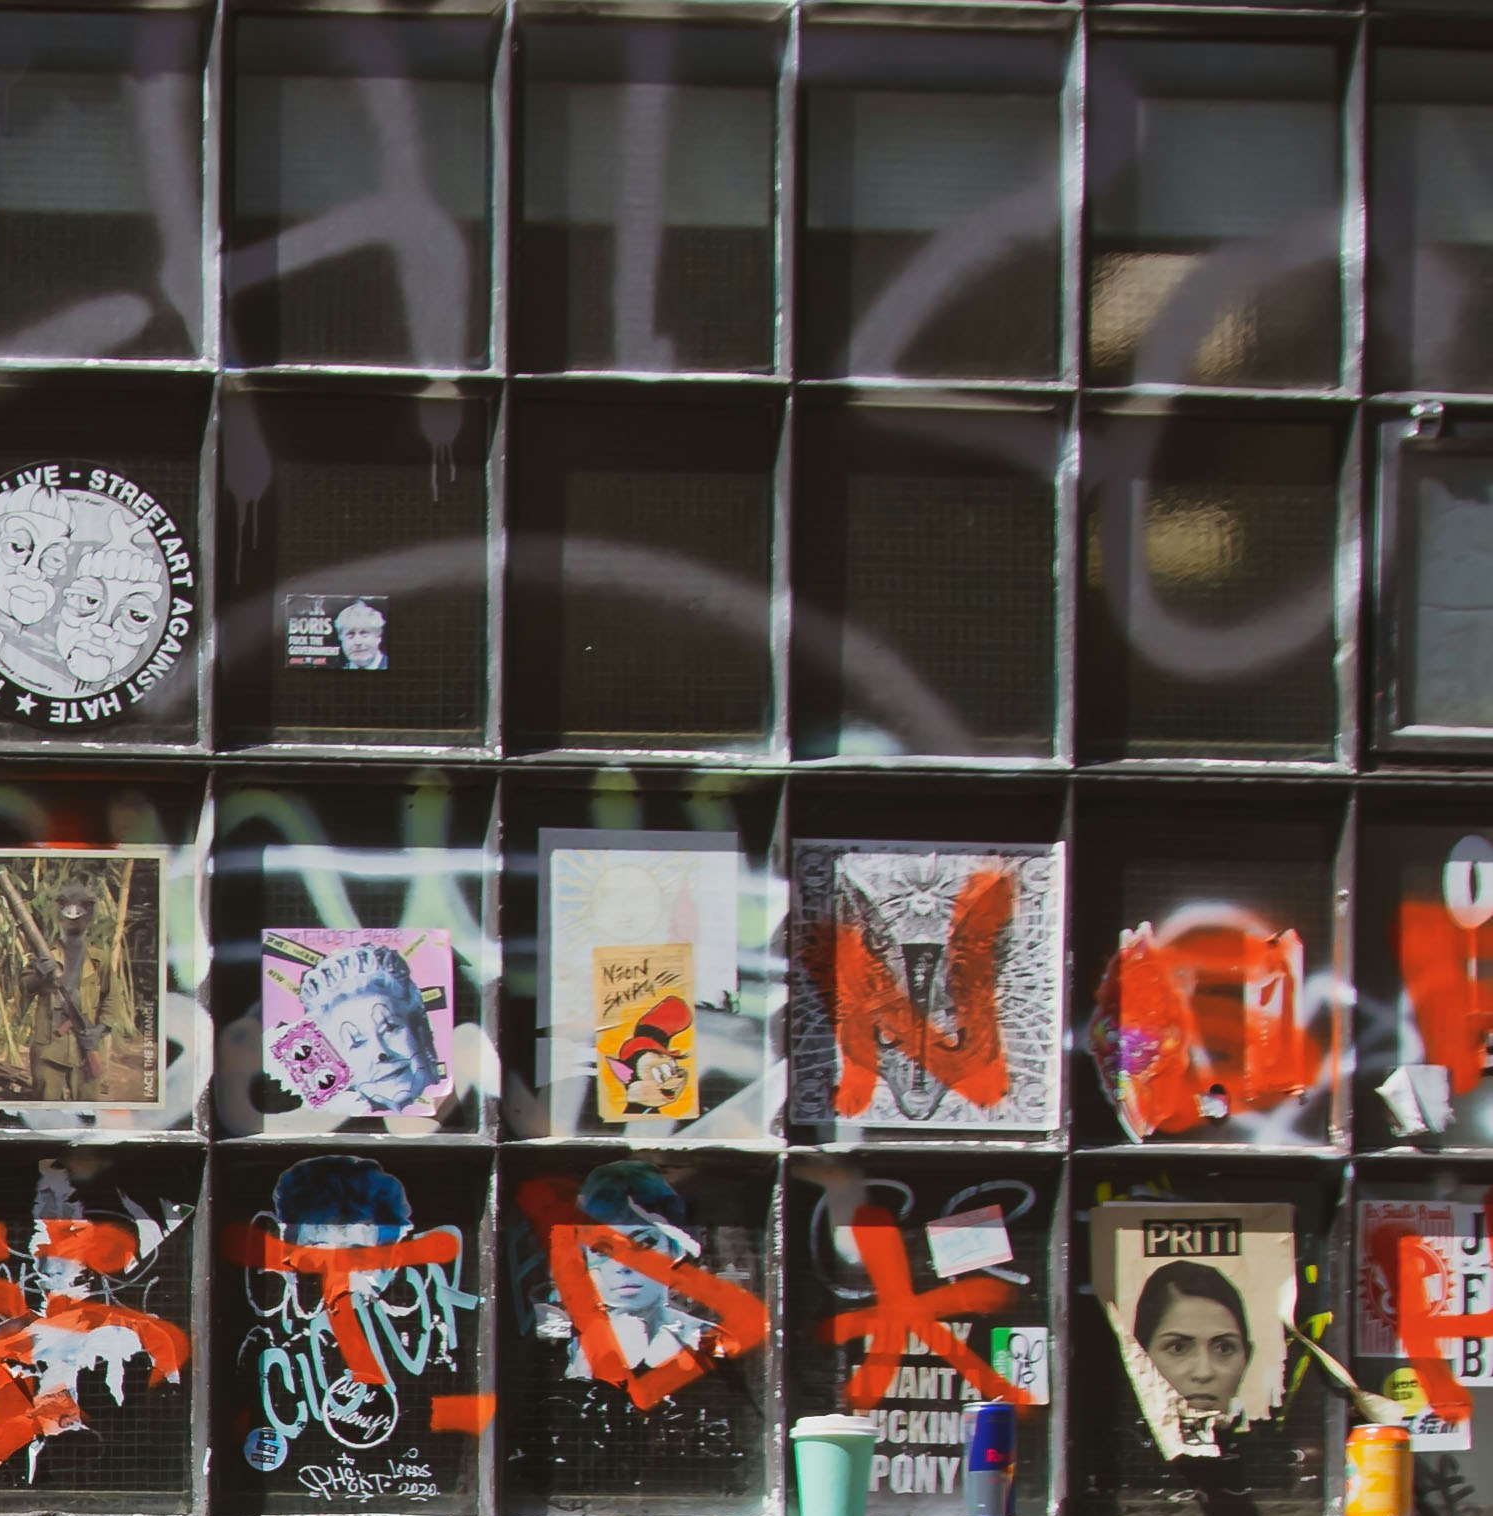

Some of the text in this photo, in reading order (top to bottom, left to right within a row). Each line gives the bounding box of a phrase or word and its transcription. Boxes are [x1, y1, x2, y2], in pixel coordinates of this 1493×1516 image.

[288, 617, 334, 636] BORIS
[131, 596, 194, 704] AGAINST
[48, 691, 123, 723] HATE
[142, 1000, 154, 1098] FACE THE STRANGE
[1145, 1221, 1241, 1256] PRITI
[867, 1454, 961, 1495] PONY
